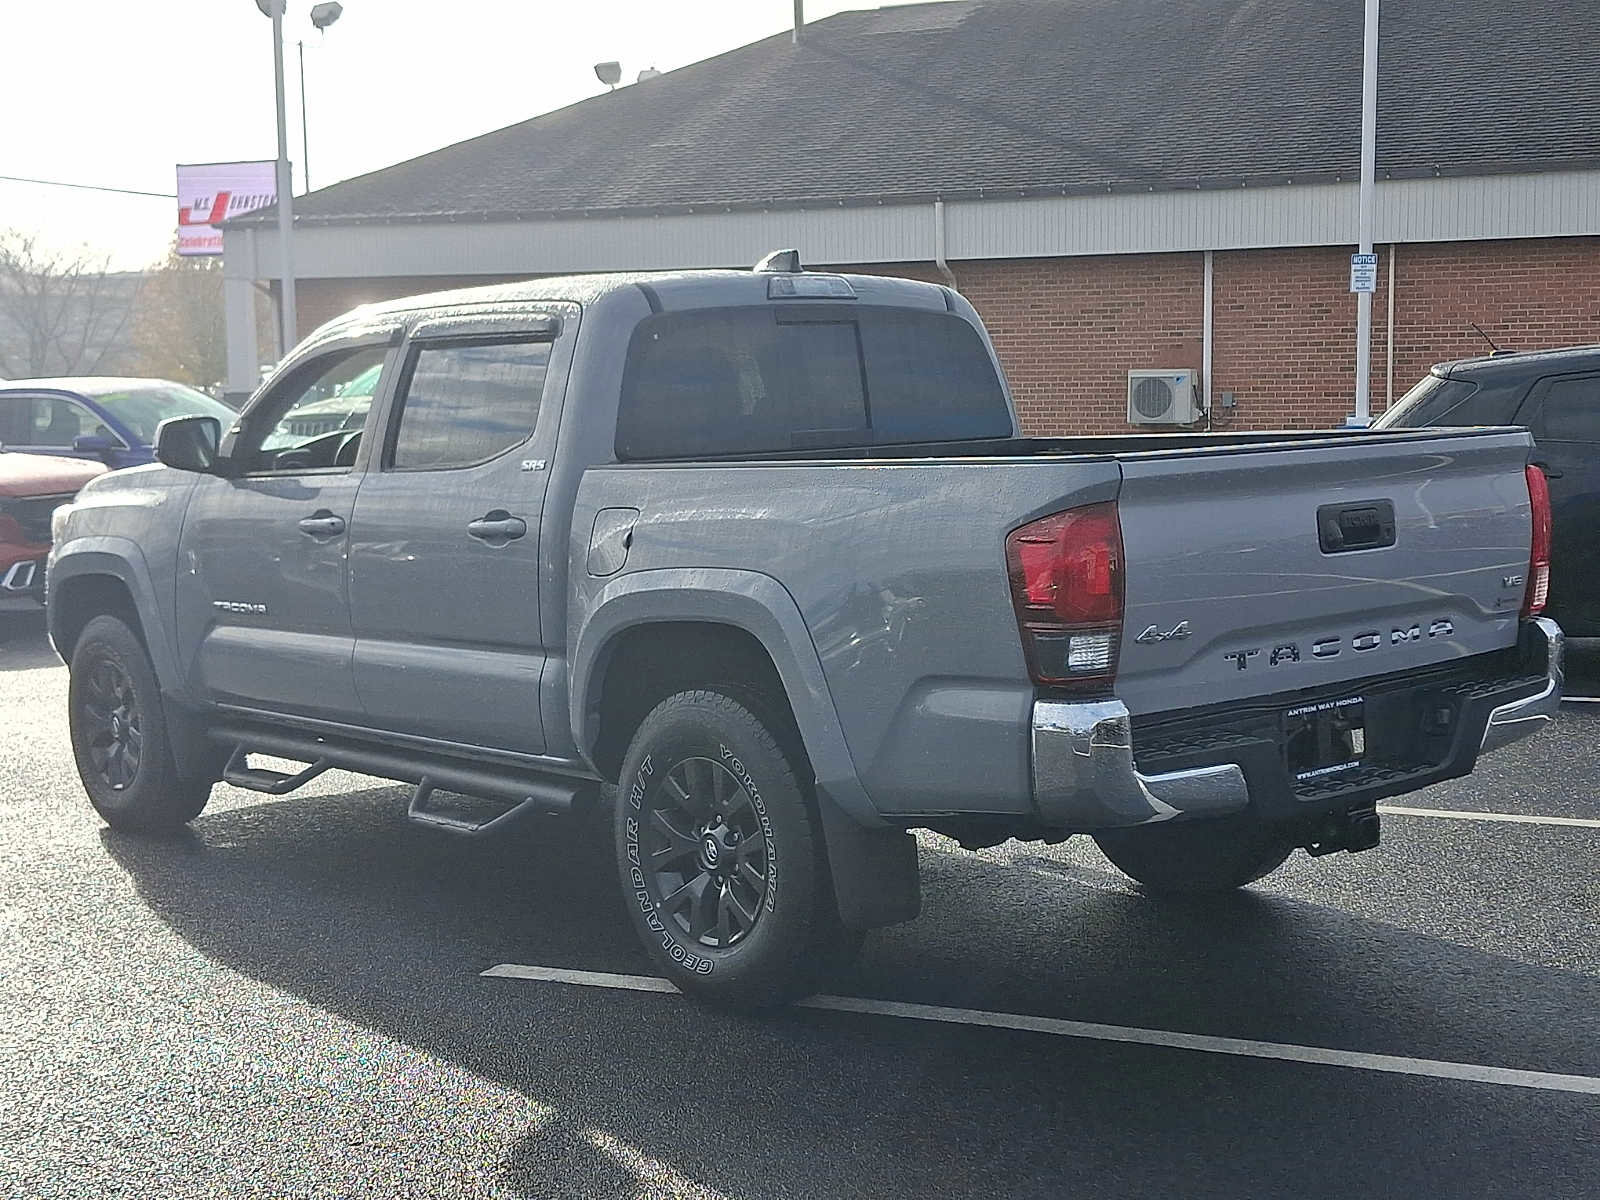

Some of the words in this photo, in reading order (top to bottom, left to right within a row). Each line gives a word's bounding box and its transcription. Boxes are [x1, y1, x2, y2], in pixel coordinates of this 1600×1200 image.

[1353, 255, 1375, 263] NOTICE
[521, 459, 547, 471] SR5
[213, 600, 267, 613] TACOMA
[1223, 616, 1455, 672] TACOMA
[1287, 704, 1317, 716] ANTRIM
[1318, 702, 1335, 711] WAY
[1336, 696, 1364, 707] HONDA
[629, 753, 655, 810] H/T
[719, 743, 777, 913] YOKOHAMA
[626, 816, 715, 976] GEOLANDAR
